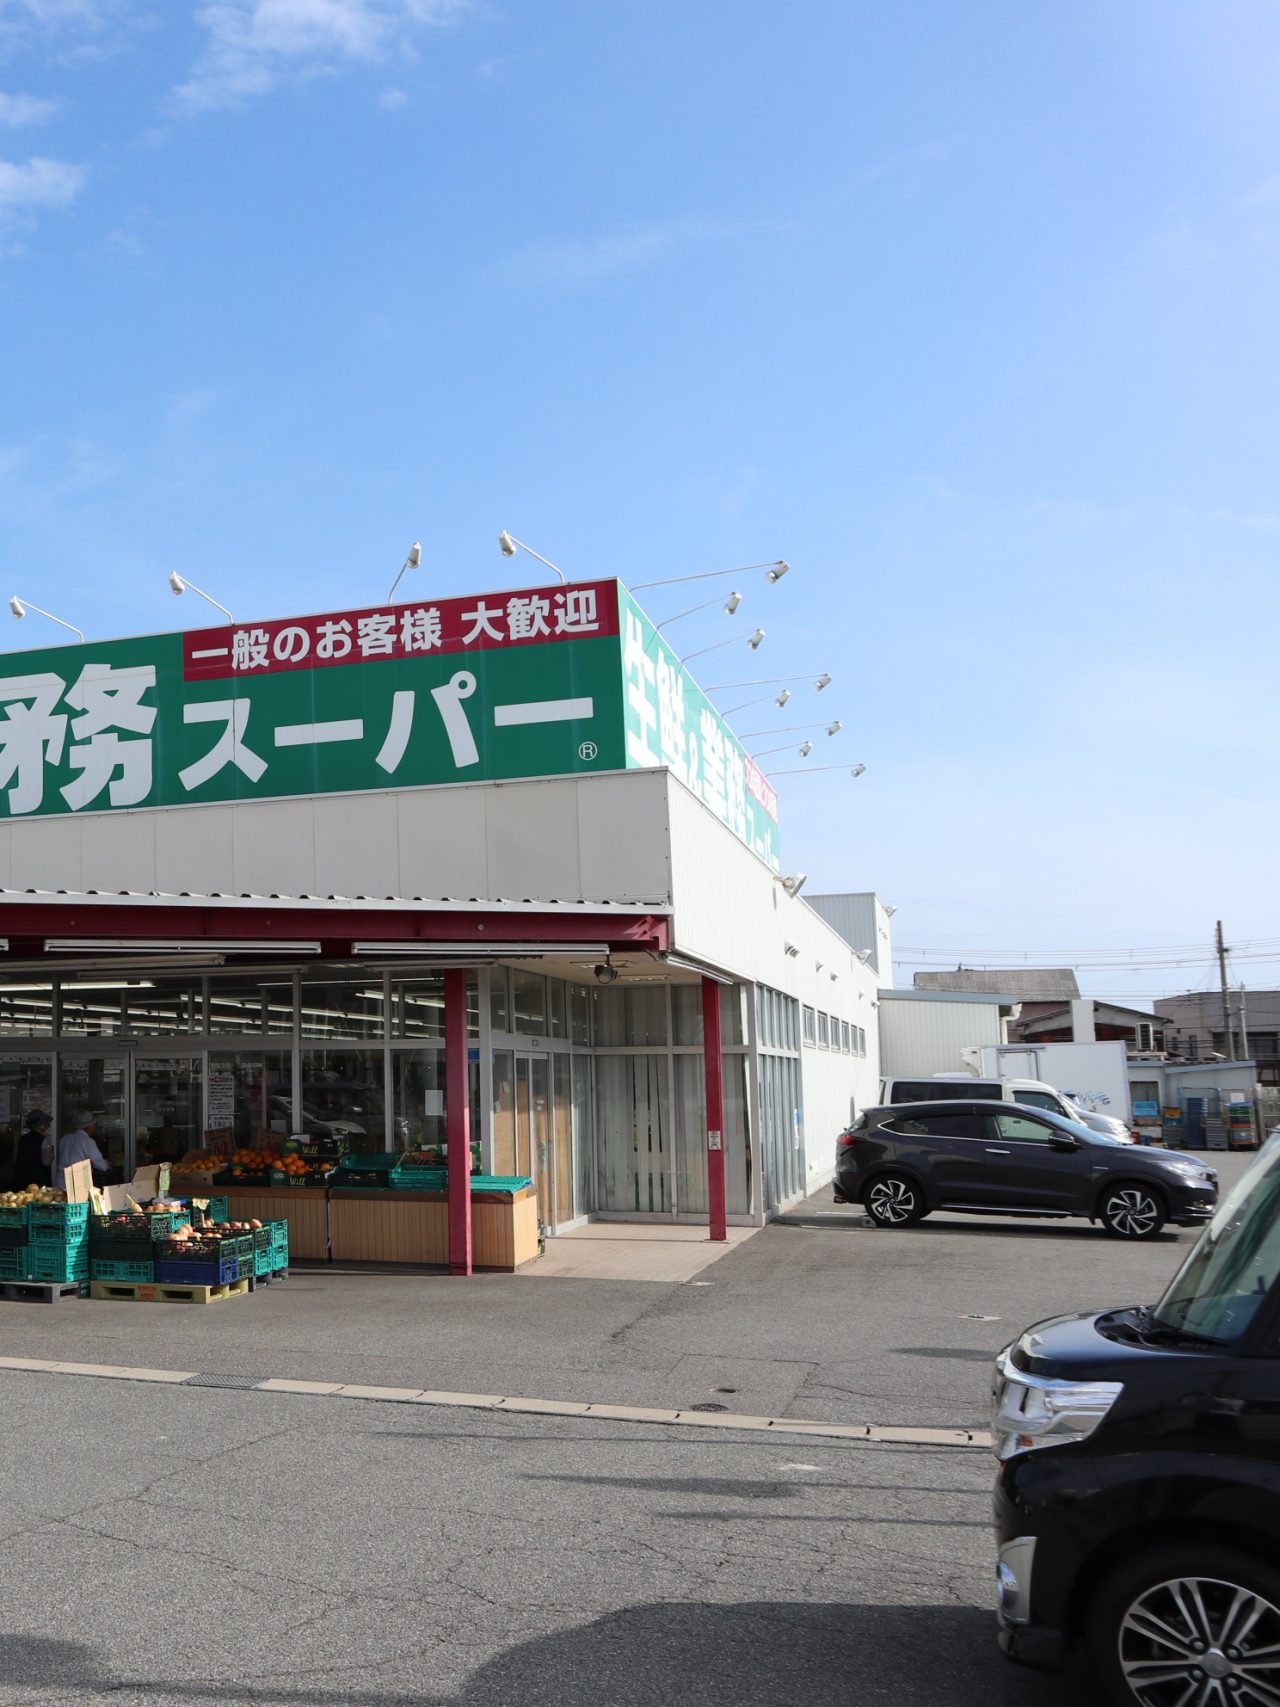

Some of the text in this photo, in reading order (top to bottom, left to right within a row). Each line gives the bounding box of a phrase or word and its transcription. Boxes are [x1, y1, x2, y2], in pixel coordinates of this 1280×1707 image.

[192, 589, 600, 671] 一般のお客様 大歓迎
